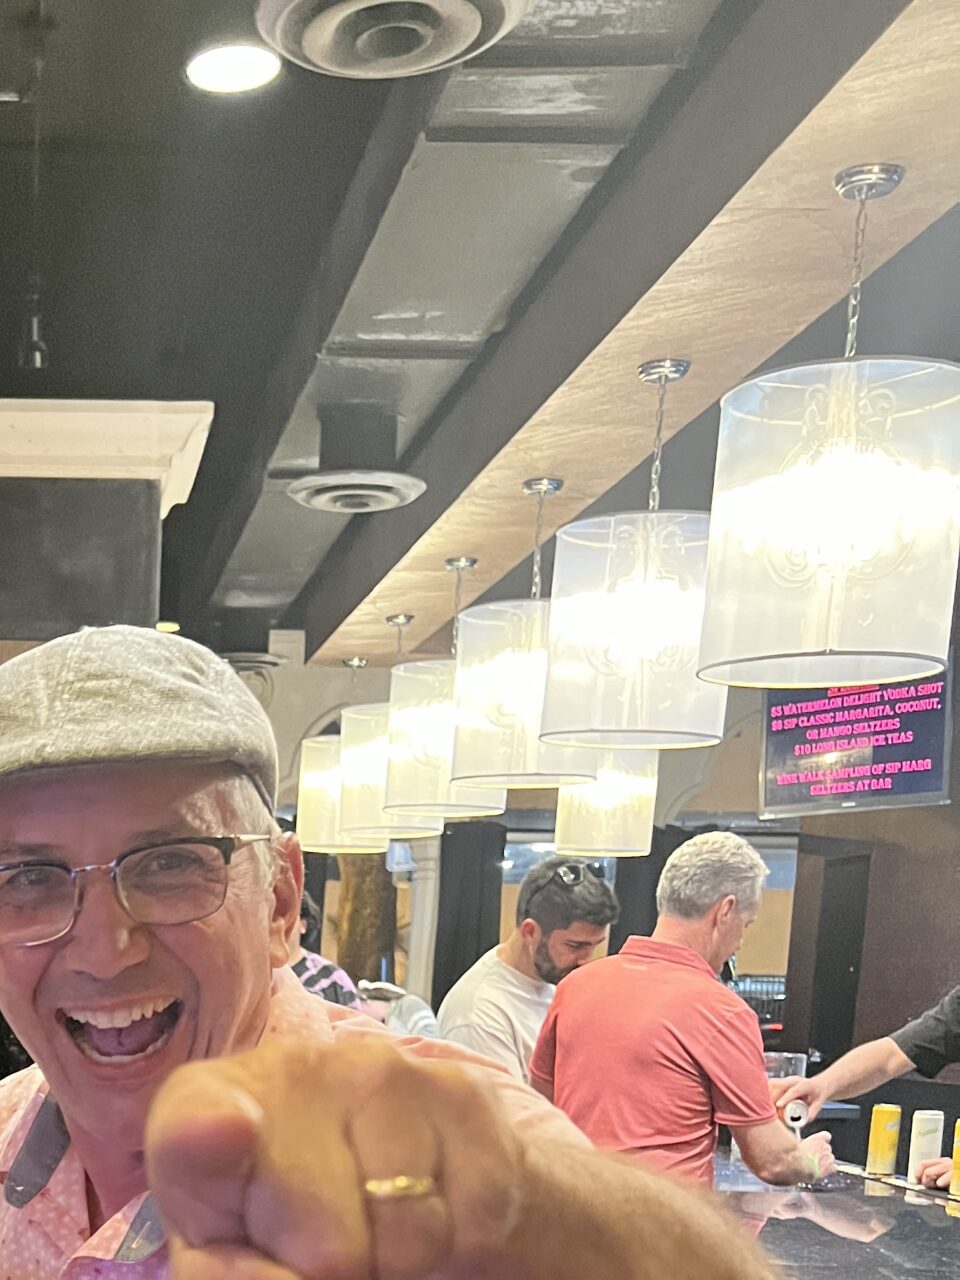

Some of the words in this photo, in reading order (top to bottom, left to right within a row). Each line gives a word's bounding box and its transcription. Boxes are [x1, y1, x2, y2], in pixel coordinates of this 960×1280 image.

[783, 697, 842, 715] WATERMELON
[844, 691, 882, 707] DELIGHT
[883, 686, 916, 700] VODKA
[917, 682, 944, 695] SHOT
[784, 718, 798, 729] SIP
[799, 712, 834, 727] CLASSIC
[835, 705, 894, 722] MARGARITA,
[895, 698, 941, 713] COCONUT,
[806, 729, 819, 740] OR
[819, 725, 852, 738] MANGO
[853, 718, 900, 734] SELTZERS
[794, 744, 811, 755] $10
[812, 741, 835, 753] LONG
[836, 737, 869, 750] ISLAND
[870, 734, 886, 746] ICE
[887, 731, 913, 744] TEAS
[798, 771, 824, 783] WALK
[825, 766, 871, 780] SAMPLING
[872, 763, 885, 775] OF
[885, 761, 902, 773] SIP
[902, 759, 932, 772] MARG
[810, 780, 856, 795] SELTZERS
[856, 779, 870, 791] AT
[871, 777, 892, 790] BAR
